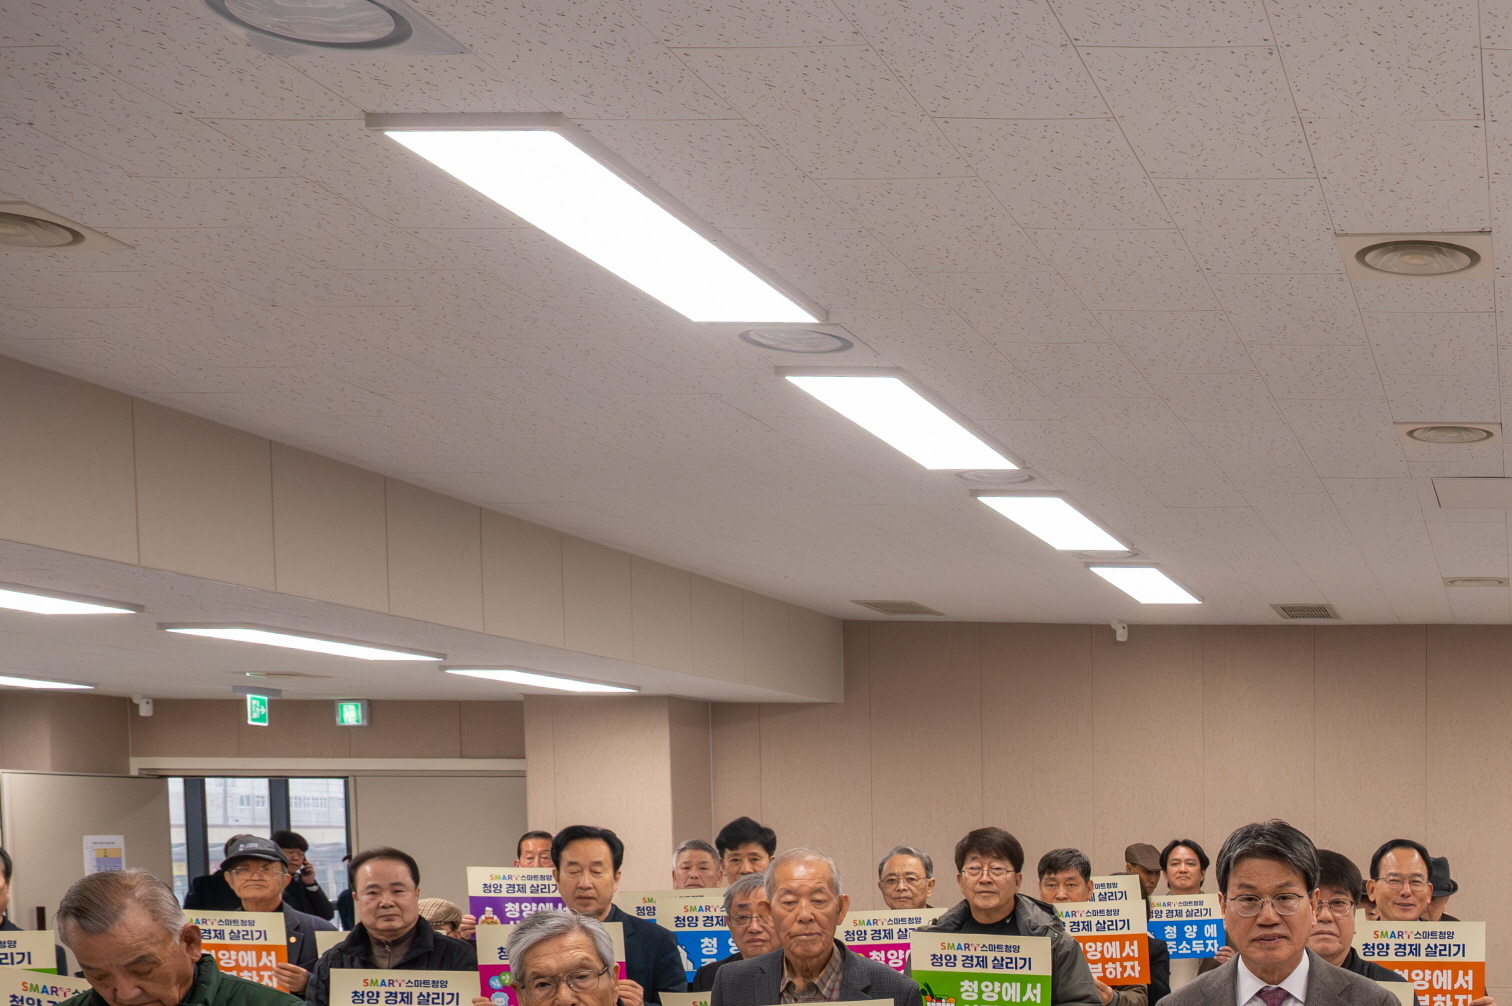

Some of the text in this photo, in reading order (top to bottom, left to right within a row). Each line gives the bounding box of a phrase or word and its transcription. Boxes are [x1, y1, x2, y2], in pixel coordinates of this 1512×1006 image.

[482, 883, 503, 893] 청양
[505, 883, 526, 894] 경제
[635, 906, 656, 916] 청양
[1058, 910, 1084, 918] MART
[1165, 908, 1183, 918] 경제
[1186, 908, 1212, 917] 살리기
[674, 916, 699, 927] 청양
[1070, 919, 1130, 932] 경제 살리기
[229, 930, 268, 941] 살리기
[844, 930, 867, 942] 청양
[870, 928, 893, 940] 경제
[1081, 940, 1139, 960] 양에서
[1362, 942, 1466, 957] 청양 경제 살리기
[0, 952, 31, 965] 리기
[930, 953, 1031, 970] 청양 경제 살리기
[1088, 961, 1140, 979] 부하자
[960, 980, 1041, 1003] 청양에서
[351, 991, 460, 1006] 청양 경제 살리기
